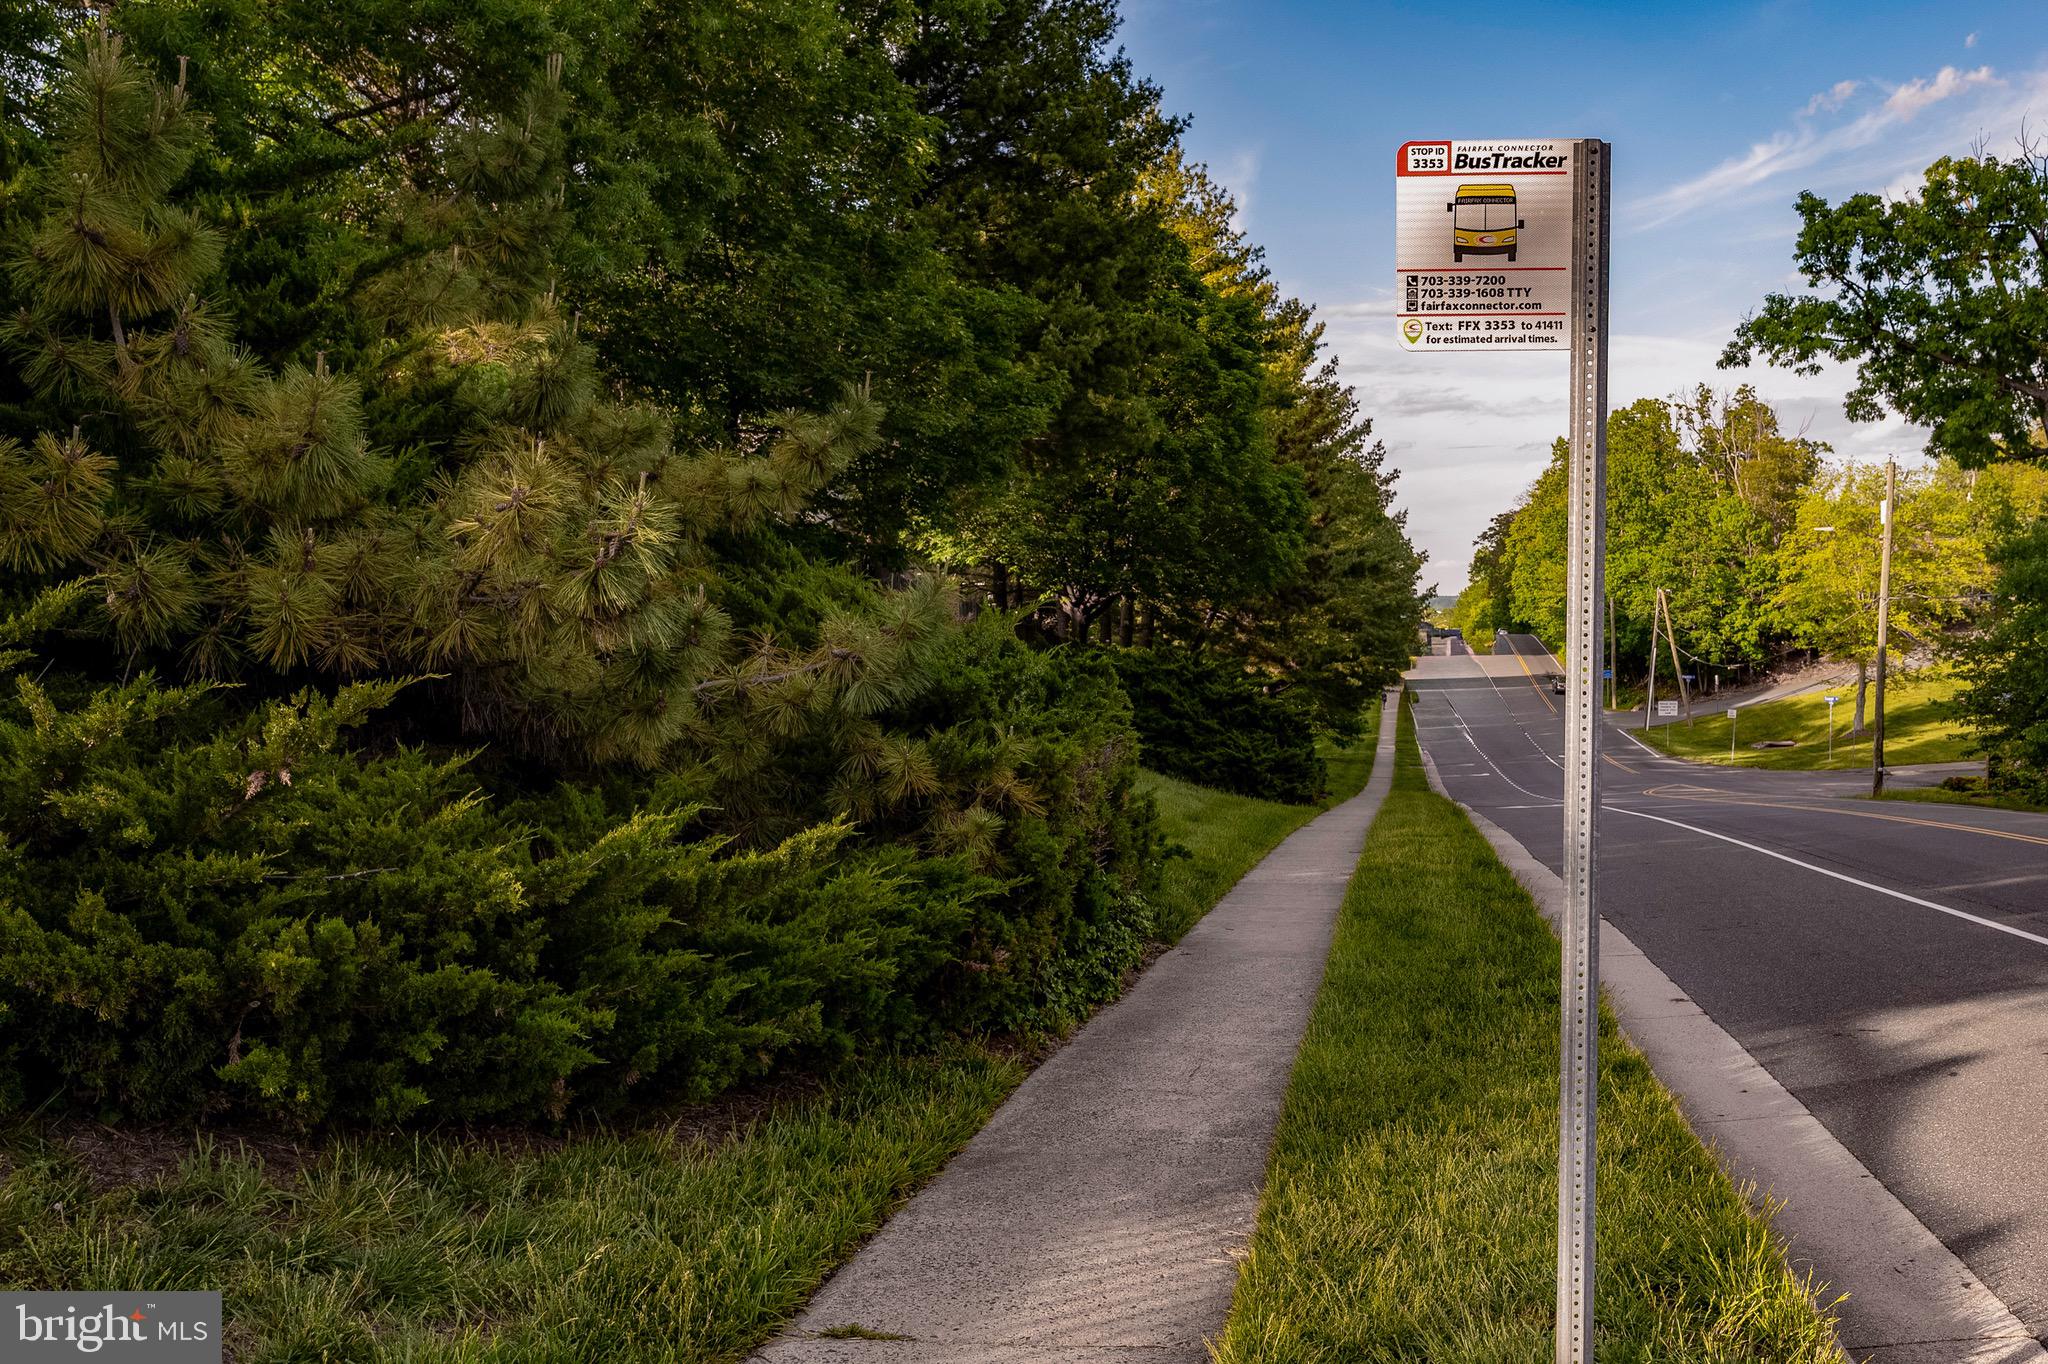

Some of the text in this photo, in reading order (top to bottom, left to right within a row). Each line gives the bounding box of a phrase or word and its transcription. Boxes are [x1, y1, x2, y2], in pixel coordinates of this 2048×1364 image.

[1411, 148, 1432, 156] STOP
[1413, 159, 1444, 169] 3353
[1454, 152, 1567, 169] BusTracker
[1421, 276, 1505, 286] 703-339-7200
[1421, 288, 1532, 298] 703-339-1608 TTY
[1421, 301, 1542, 310] fairfaxconnector.com
[1425, 321, 1563, 331] Text: FFX 3353 to 41411
[1426, 334, 1558, 344] for estimated arrival times.
